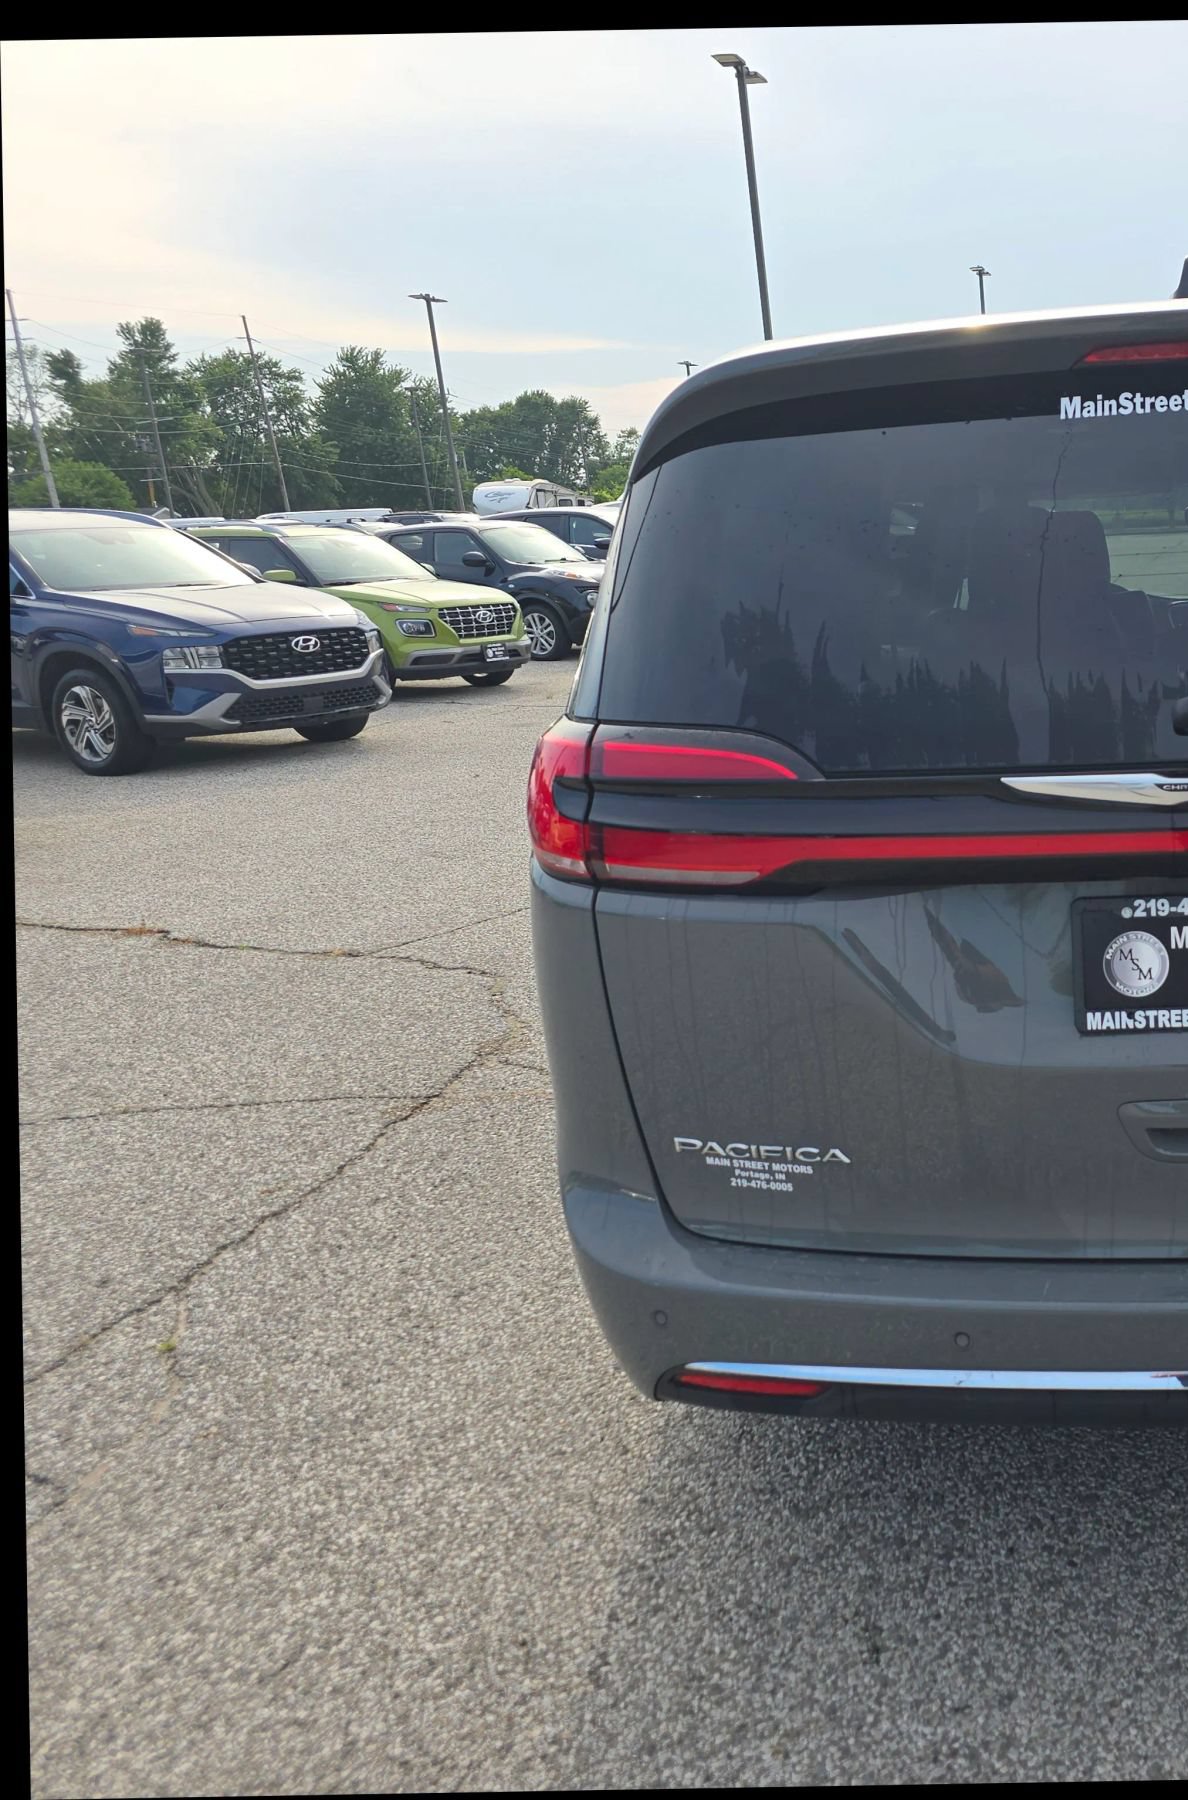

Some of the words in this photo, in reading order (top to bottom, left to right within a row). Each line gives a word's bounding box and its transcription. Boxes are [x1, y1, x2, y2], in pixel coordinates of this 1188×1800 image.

[1105, 935, 1128, 960] MAIN
[673, 1137, 851, 1163] PACIFICA
[706, 1157, 730, 1167] MAIN
[732, 1159, 769, 1171] STREET
[772, 1164, 813, 1174] MOTORS
[735, 1169, 773, 1181] Portage,
[775, 1173, 785, 1181] IN
[730, 1178, 793, 1192] 219-476-0005
